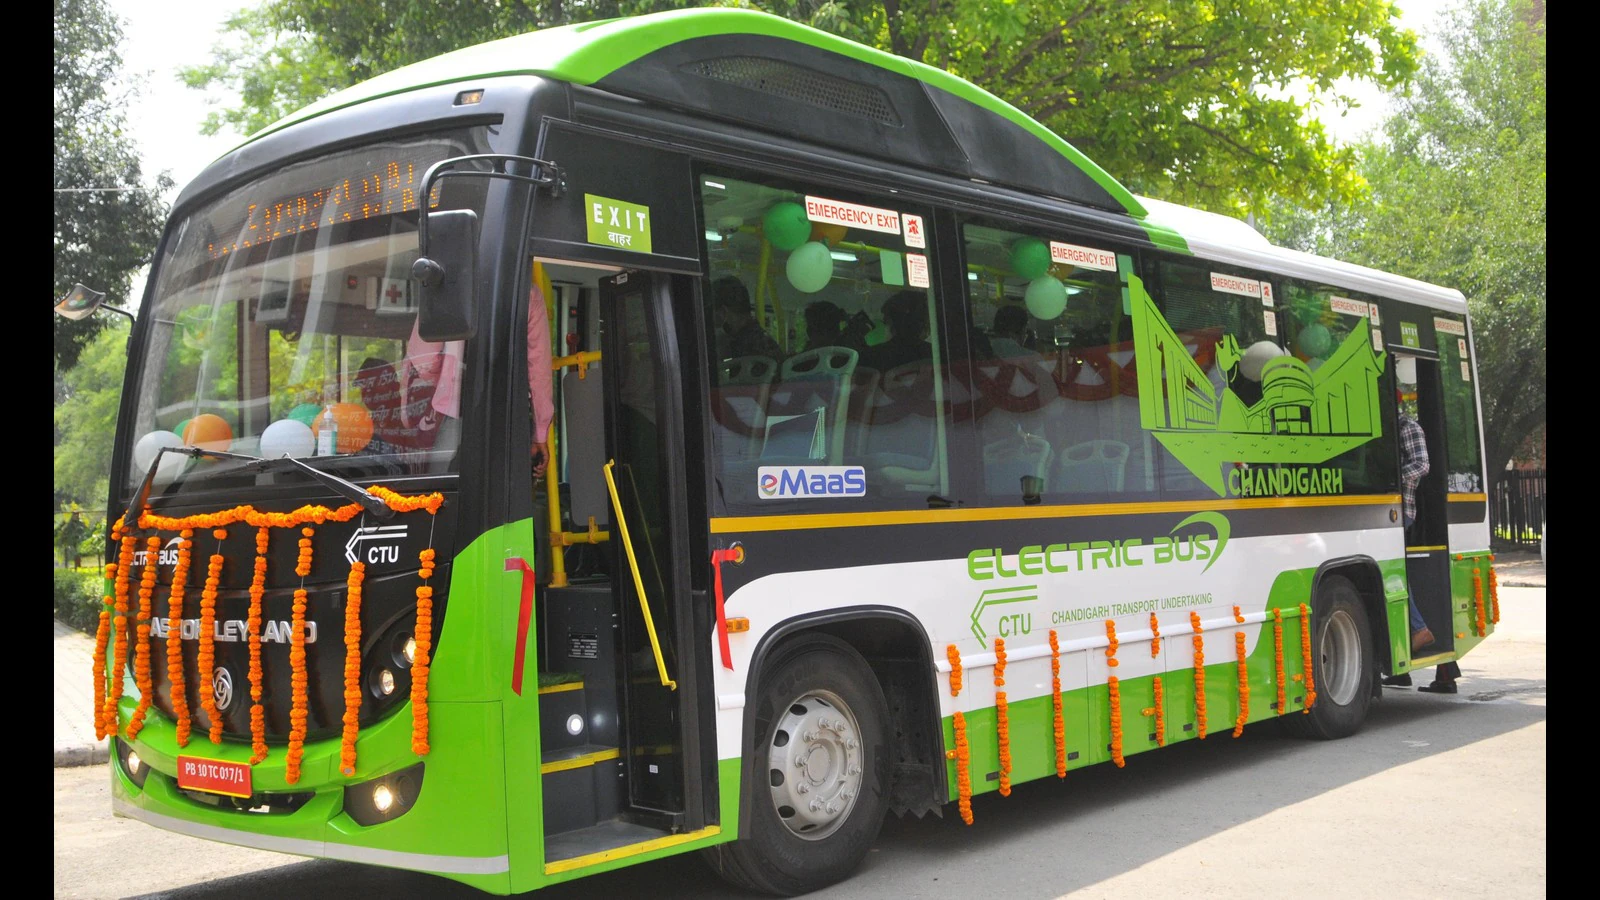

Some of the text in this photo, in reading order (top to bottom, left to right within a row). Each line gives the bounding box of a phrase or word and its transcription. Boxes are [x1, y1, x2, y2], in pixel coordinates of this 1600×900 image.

[593, 203, 646, 232] EXIT
[807, 202, 898, 229] EMERGENCY EXIT
[607, 231, 632, 246] बाहर
[1051, 246, 1116, 267] EMERGENCY EXIT
[1211, 276, 1260, 294] EMERGENCY EXIT
[760, 468, 865, 496] eMaaS
[1228, 467, 1343, 496] CHANDIGARH
[158, 549, 179, 566] BUS
[368, 545, 400, 564] CTU
[967, 533, 1211, 581] ELECTRIC BUS
[1051, 592, 1213, 625] CHANDIGARH TRANSPORT UNDERTAKING
[150, 616, 202, 641] ASO
[213, 619, 318, 644] LEYAND
[998, 613, 1032, 638] CTU
[185, 762, 197, 776] PB
[197, 763, 208, 778] 10
[208, 765, 219, 779] TC
